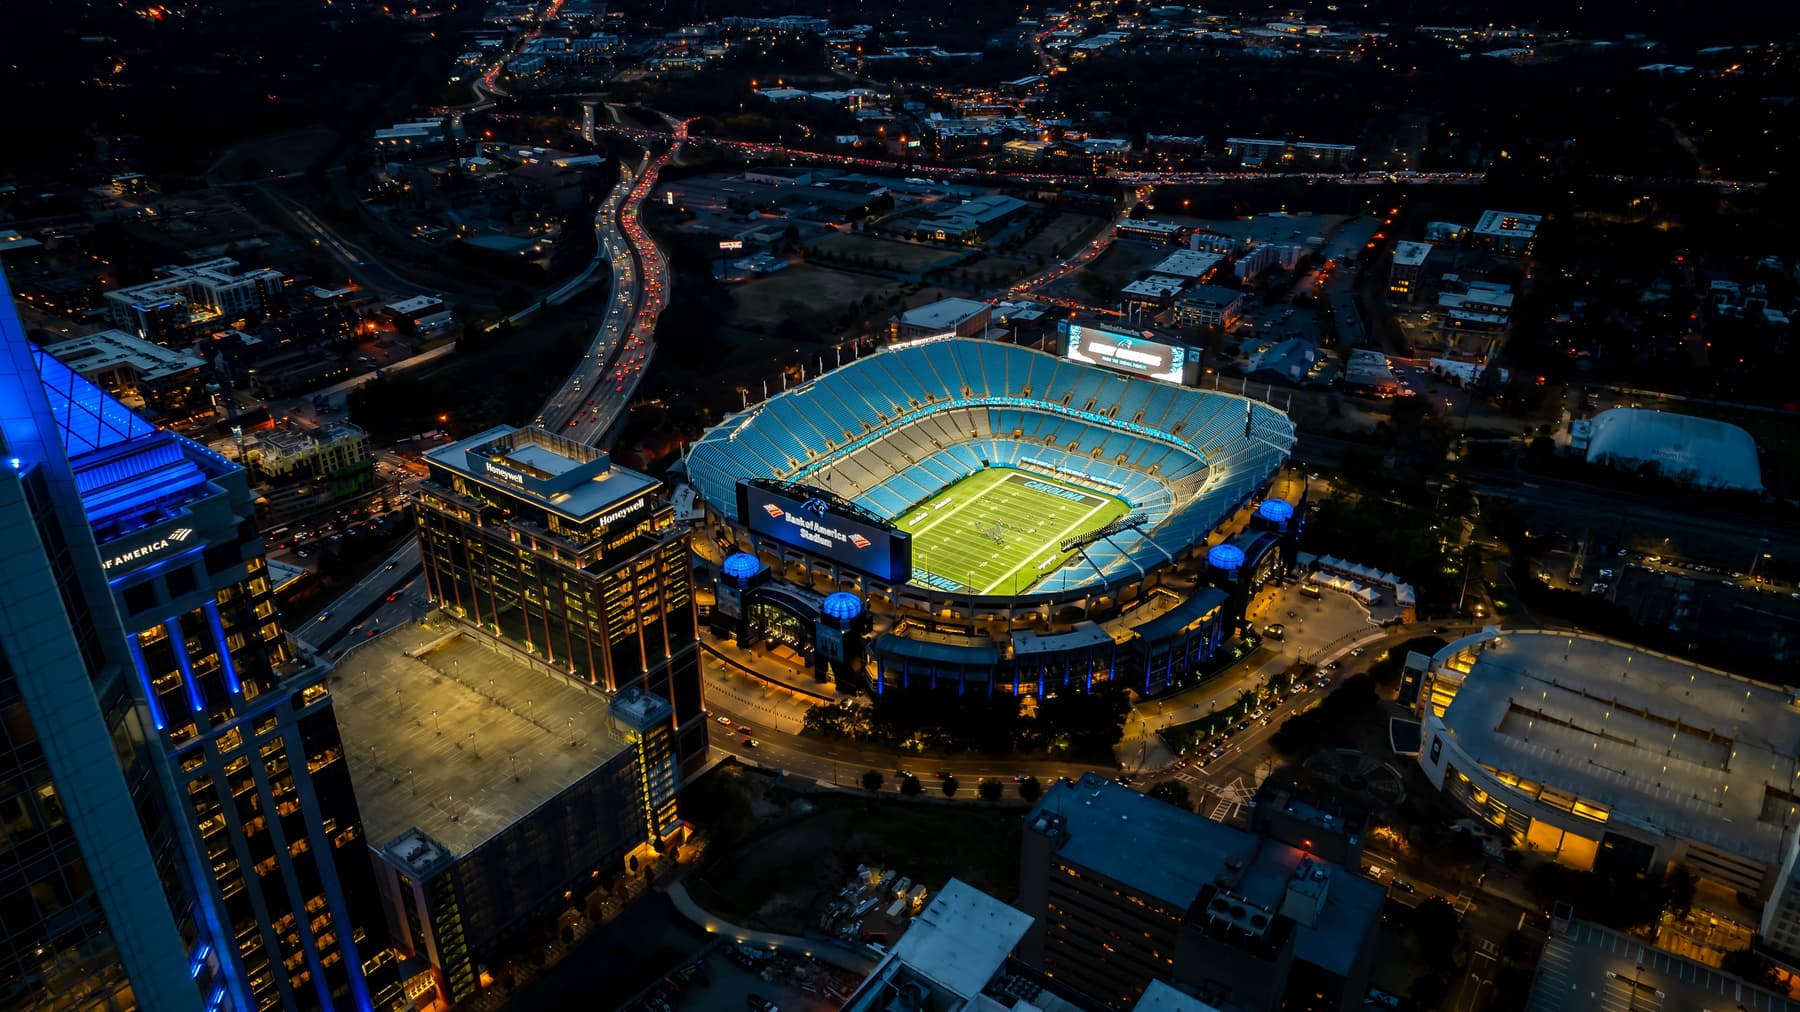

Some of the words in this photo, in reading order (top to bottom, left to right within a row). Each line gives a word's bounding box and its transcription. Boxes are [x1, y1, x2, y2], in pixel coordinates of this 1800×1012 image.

[486, 462, 523, 483] Honeywell
[1024, 480, 1086, 502] CAROLINA
[600, 498, 644, 526] Honeywell
[785, 511, 806, 528] Bank
[804, 520, 814, 531] of
[814, 522, 847, 542] America
[800, 528, 833, 548] Stadium
[114, 540, 169, 566] AMERICA
